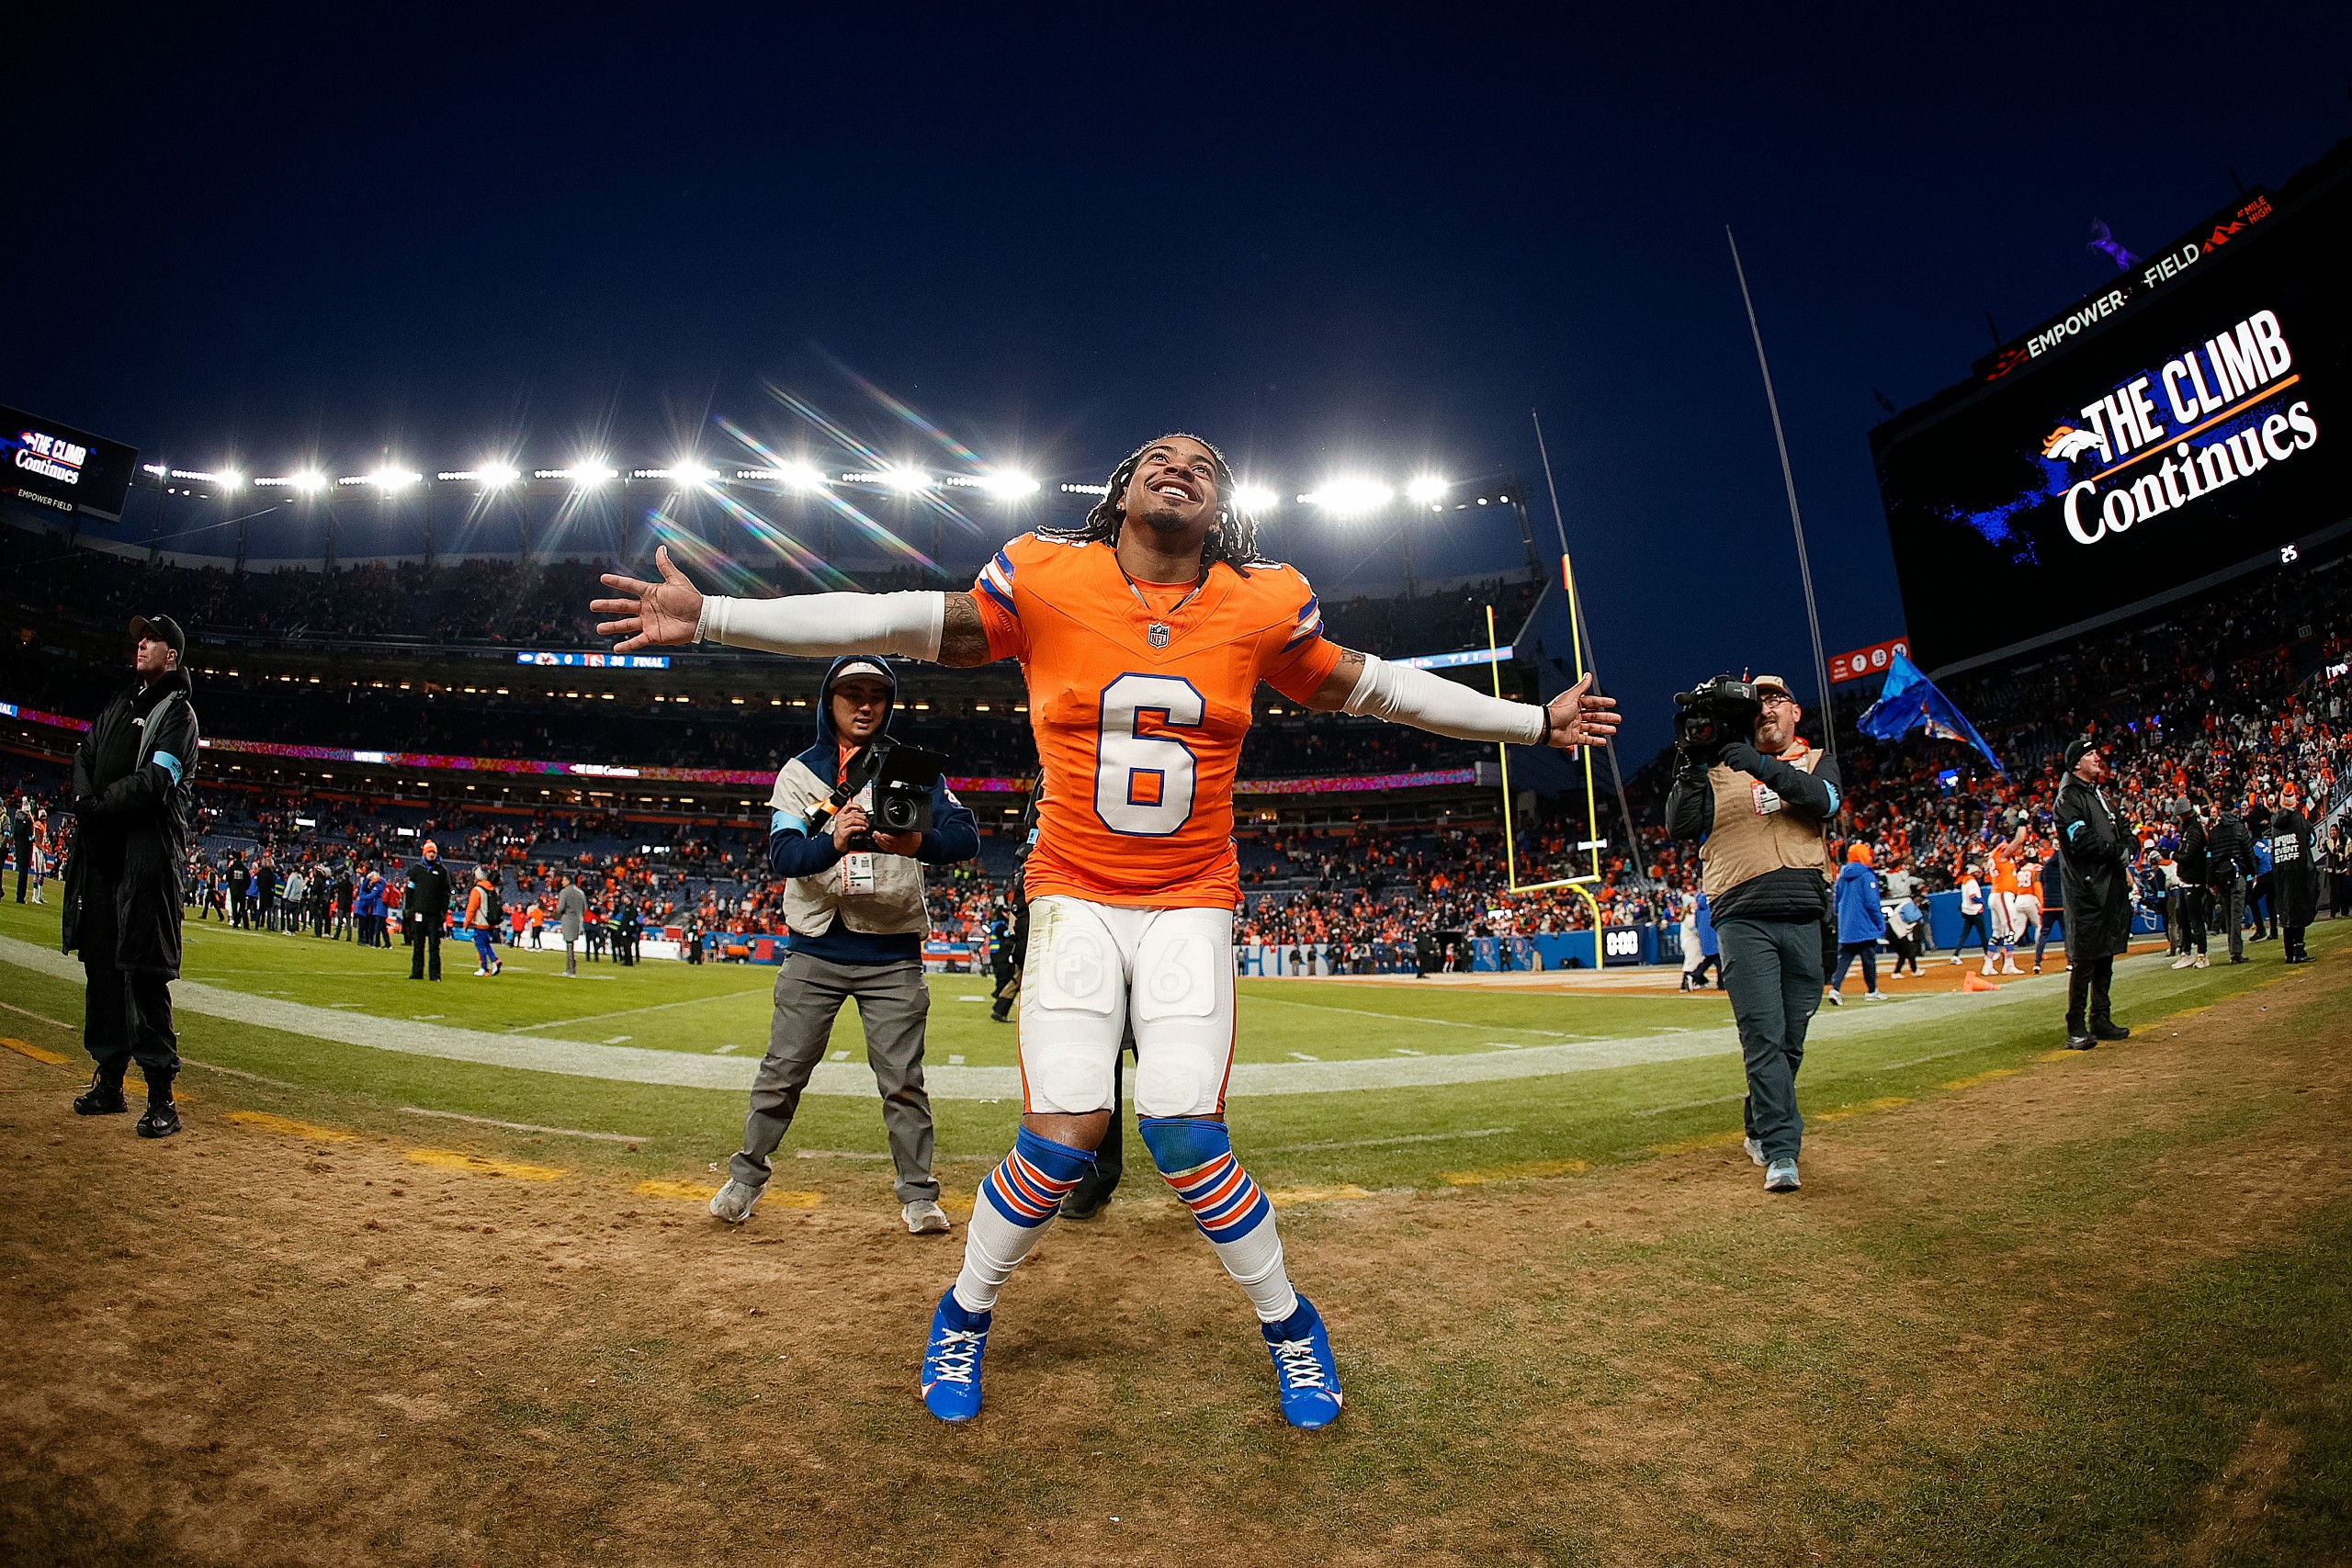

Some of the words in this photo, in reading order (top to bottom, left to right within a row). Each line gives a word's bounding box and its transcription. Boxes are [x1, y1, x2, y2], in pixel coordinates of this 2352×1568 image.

[2244, 195, 2267, 216] MILE
[2248, 203, 2273, 225] HIGH
[2027, 289, 2125, 358] EMPOWER
[2143, 243, 2199, 288] FIELD
[2080, 376, 2165, 464] THE
[2161, 310, 2292, 425] CLIMB
[35, 433, 54, 456] THE
[51, 439, 86, 467] CLIMB
[16, 448, 79, 485] Continues
[2064, 400, 2318, 546] Continues
[18, 489, 53, 506] EMPOWER
[52, 499, 73, 512] FIELD
[2280, 546, 2298, 563] 25
[1151, 634, 1166, 645] NFL
[564, 654, 573, 665] 0
[632, 657, 665, 668] FINAL
[1093, 671, 1206, 837] 6
[2274, 844, 2300, 856] EVENT
[2274, 852, 2300, 863] STAFF
[1149, 939, 1193, 1003] 6
